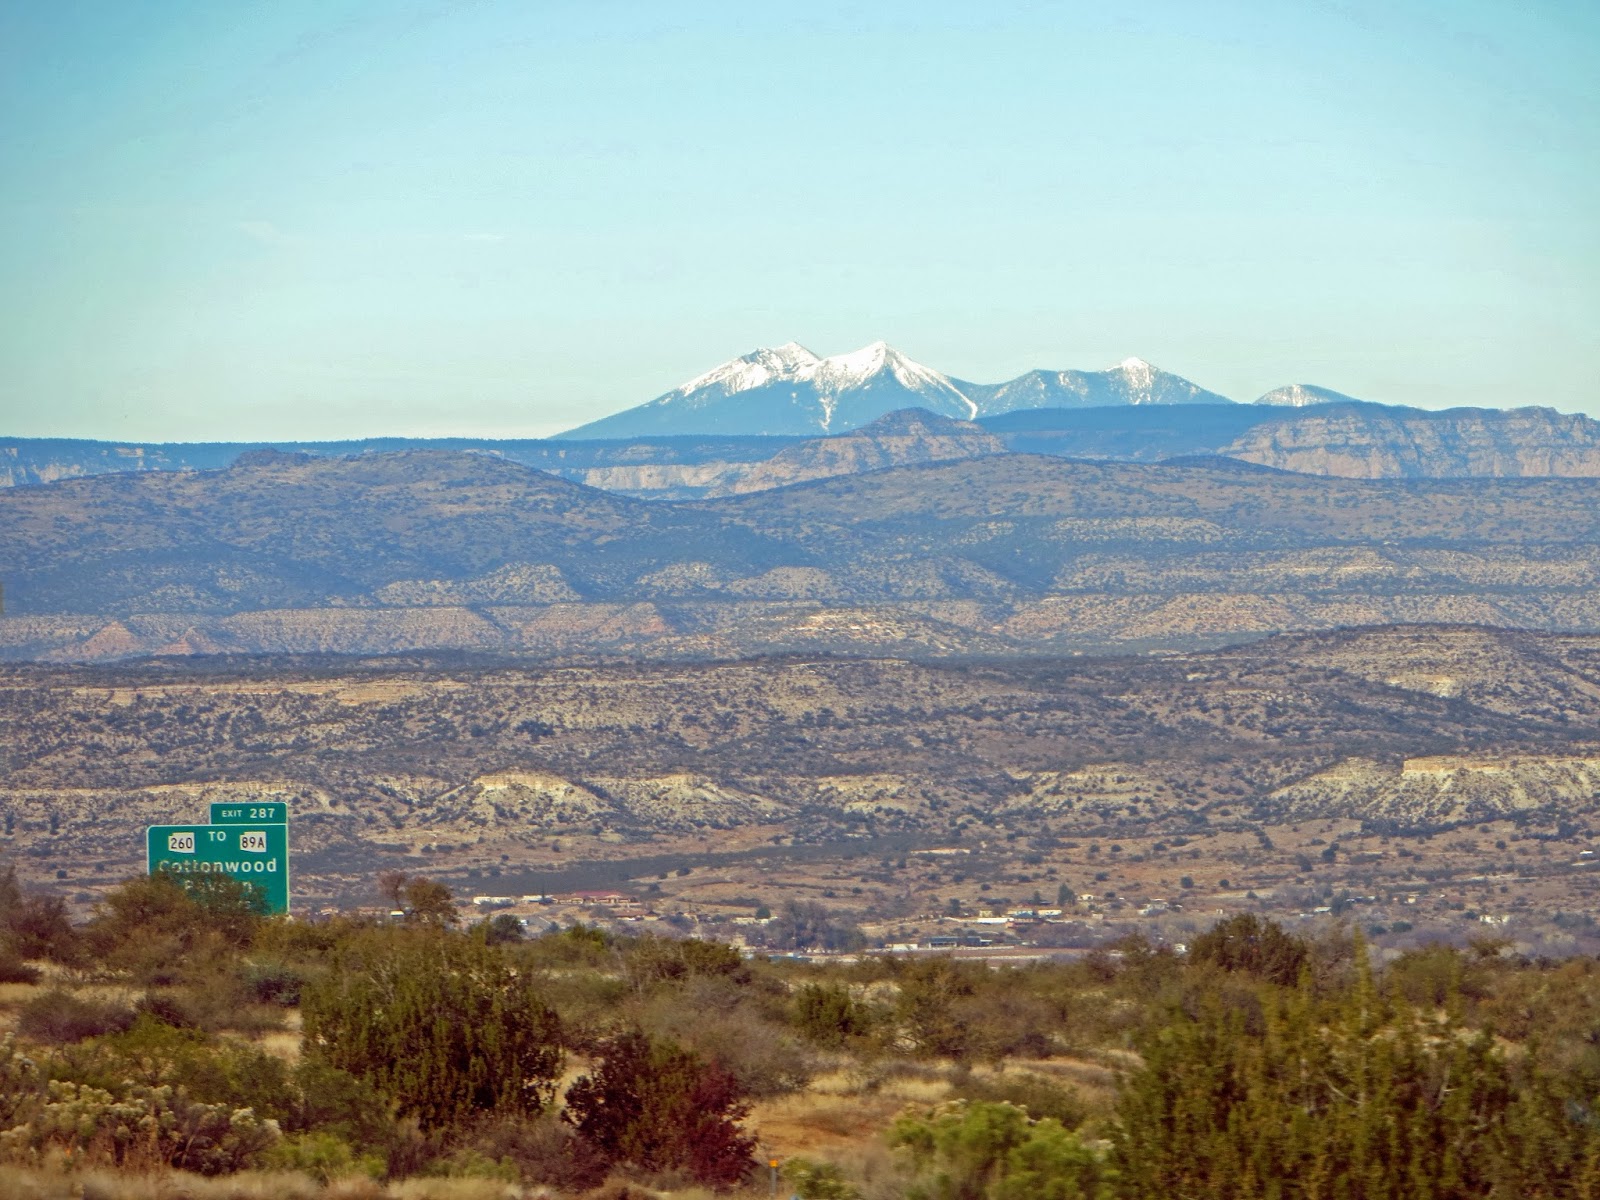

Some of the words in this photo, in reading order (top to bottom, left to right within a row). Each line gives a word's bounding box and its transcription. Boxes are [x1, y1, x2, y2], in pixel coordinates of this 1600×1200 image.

[221, 809, 243, 818] EXIT
[249, 808, 276, 819] 287
[170, 837, 193, 849] 260
[208, 831, 227, 842] TO
[241, 836, 265, 849] 89A
[158, 857, 277, 873] Cottonwood
